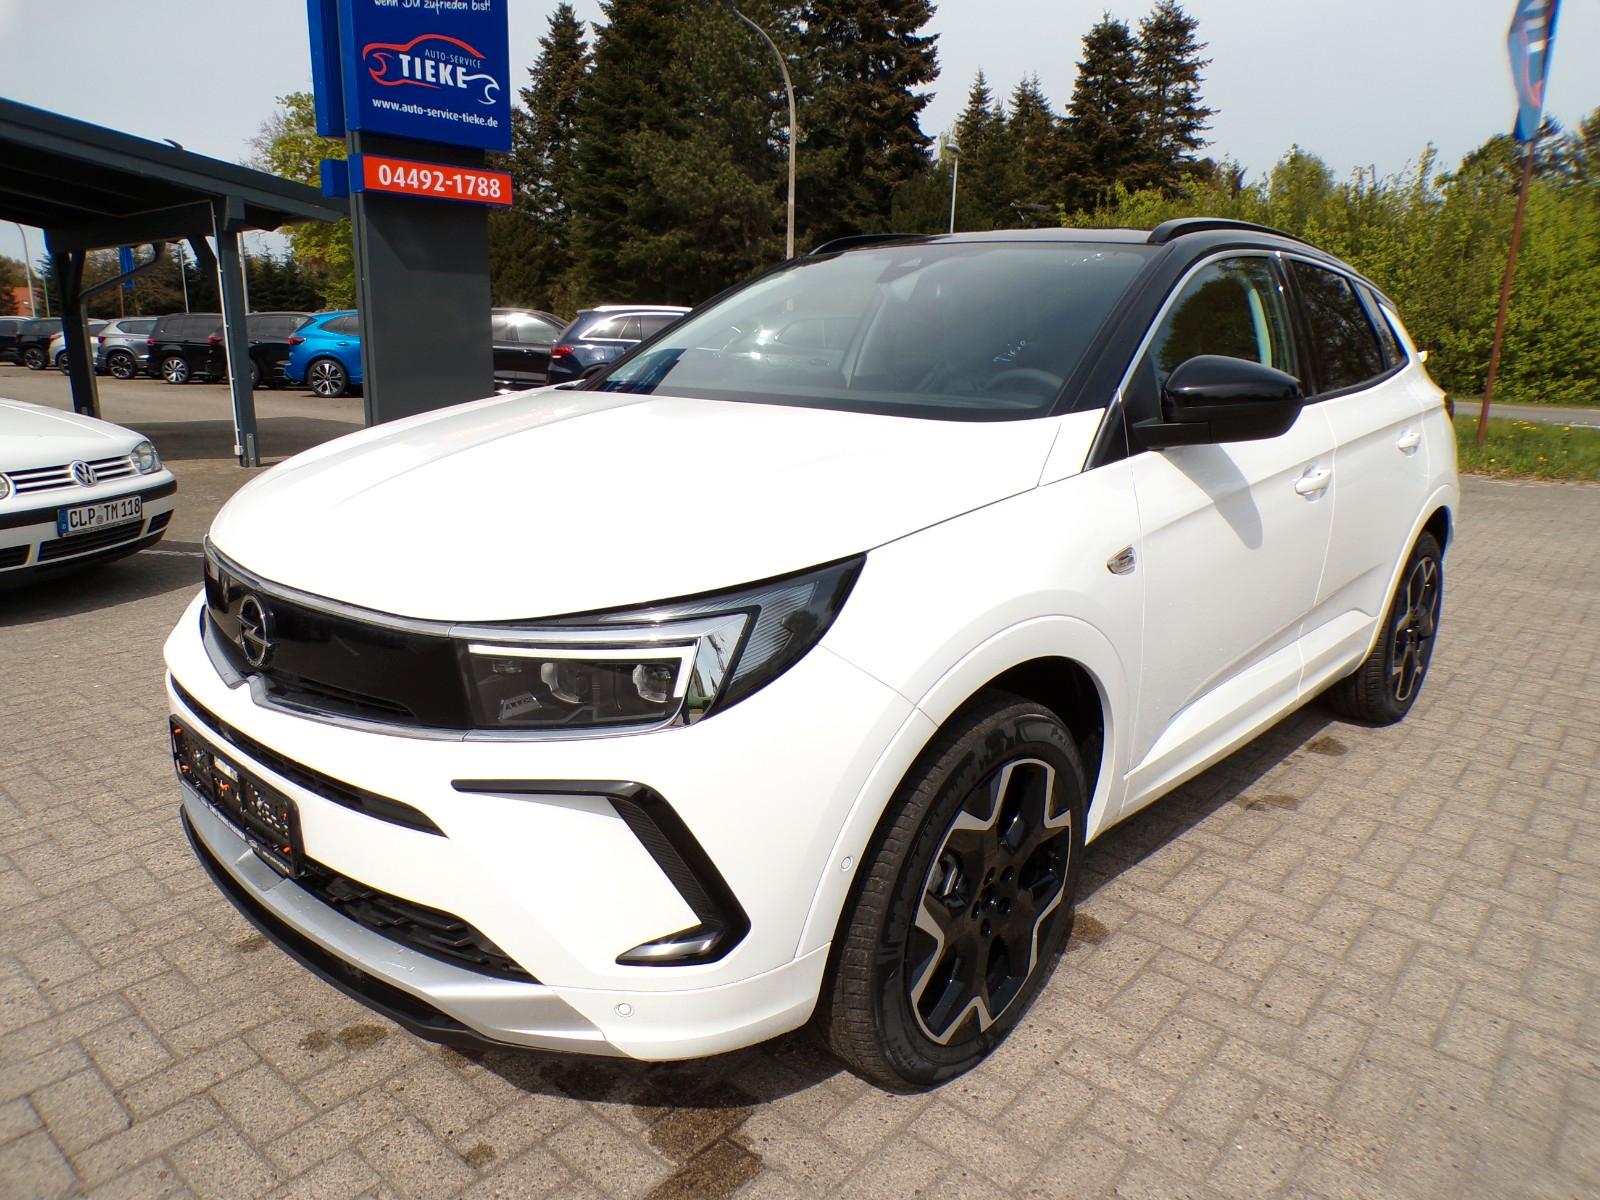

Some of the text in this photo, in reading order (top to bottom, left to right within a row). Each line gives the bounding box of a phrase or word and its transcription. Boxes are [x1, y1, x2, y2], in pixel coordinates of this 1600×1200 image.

[424, 0, 468, 15] zufrieden
[398, 54, 468, 89] TIEKE
[424, 48, 481, 69] AUTO-SERVICE
[372, 98, 498, 128] www.auto-service-tieke.de
[378, 164, 501, 198] 04492-1788
[69, 508, 96, 528] CLP
[104, 503, 118, 521] TM
[121, 498, 141, 518] 118
